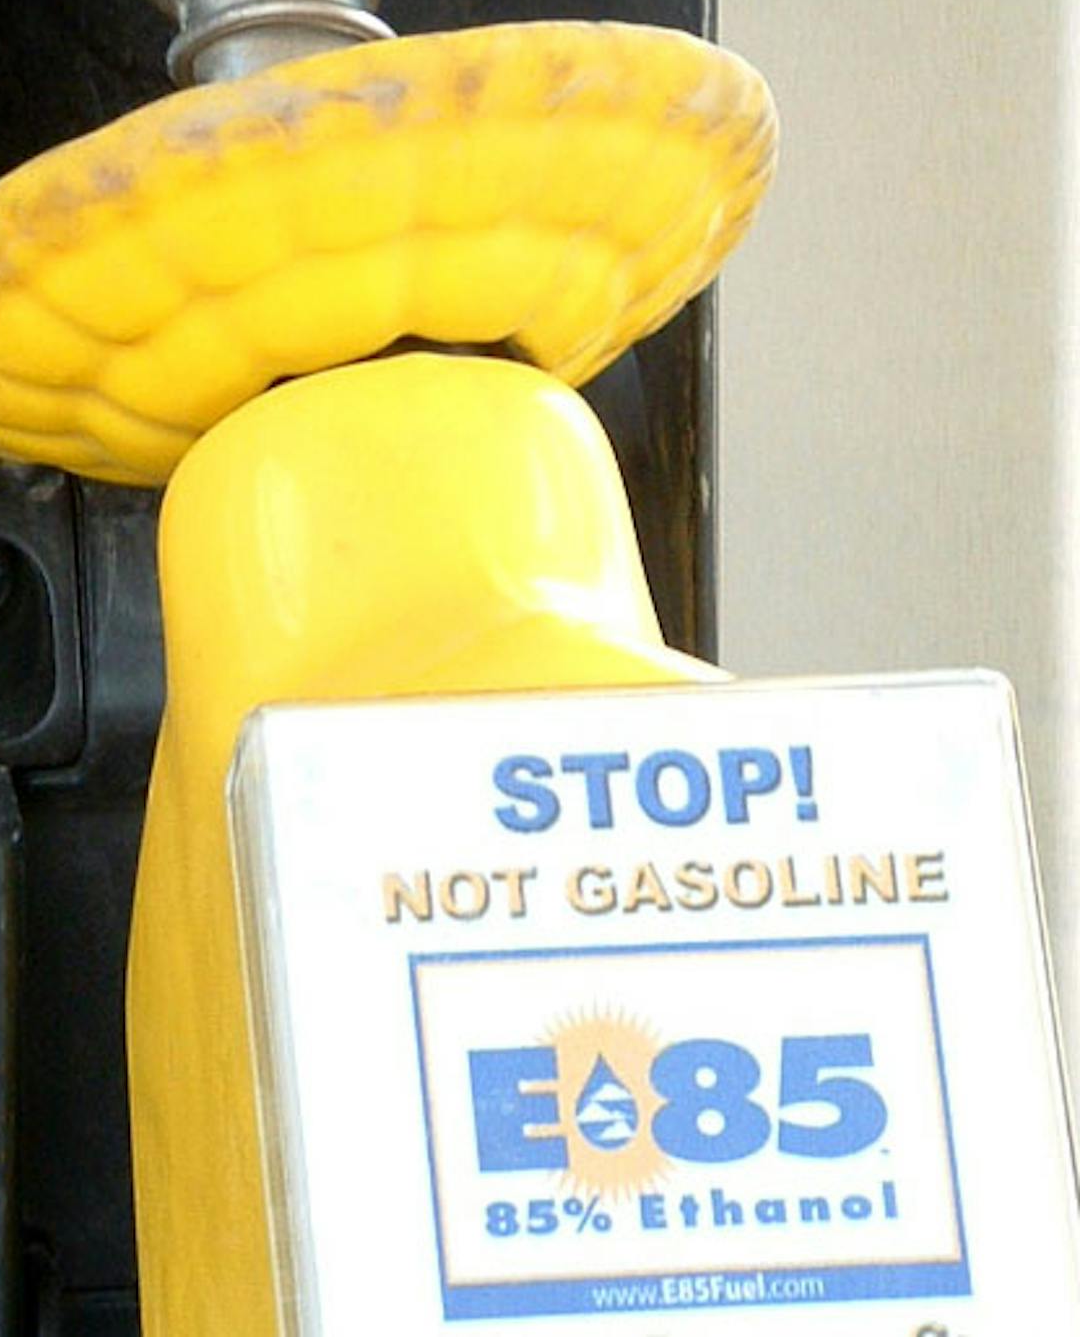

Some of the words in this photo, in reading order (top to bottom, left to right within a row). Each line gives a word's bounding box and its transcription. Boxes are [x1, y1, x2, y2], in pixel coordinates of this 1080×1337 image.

[492, 745, 819, 836] STOP!
[383, 866, 538, 925] NOT
[565, 851, 950, 918] GASOLINE
[467, 1033, 890, 1175] E85
[485, 1195, 613, 1240] 85%
[639, 1181, 899, 1232] Ethanol
[592, 1273, 825, 1310] www.E85Fuel.com
